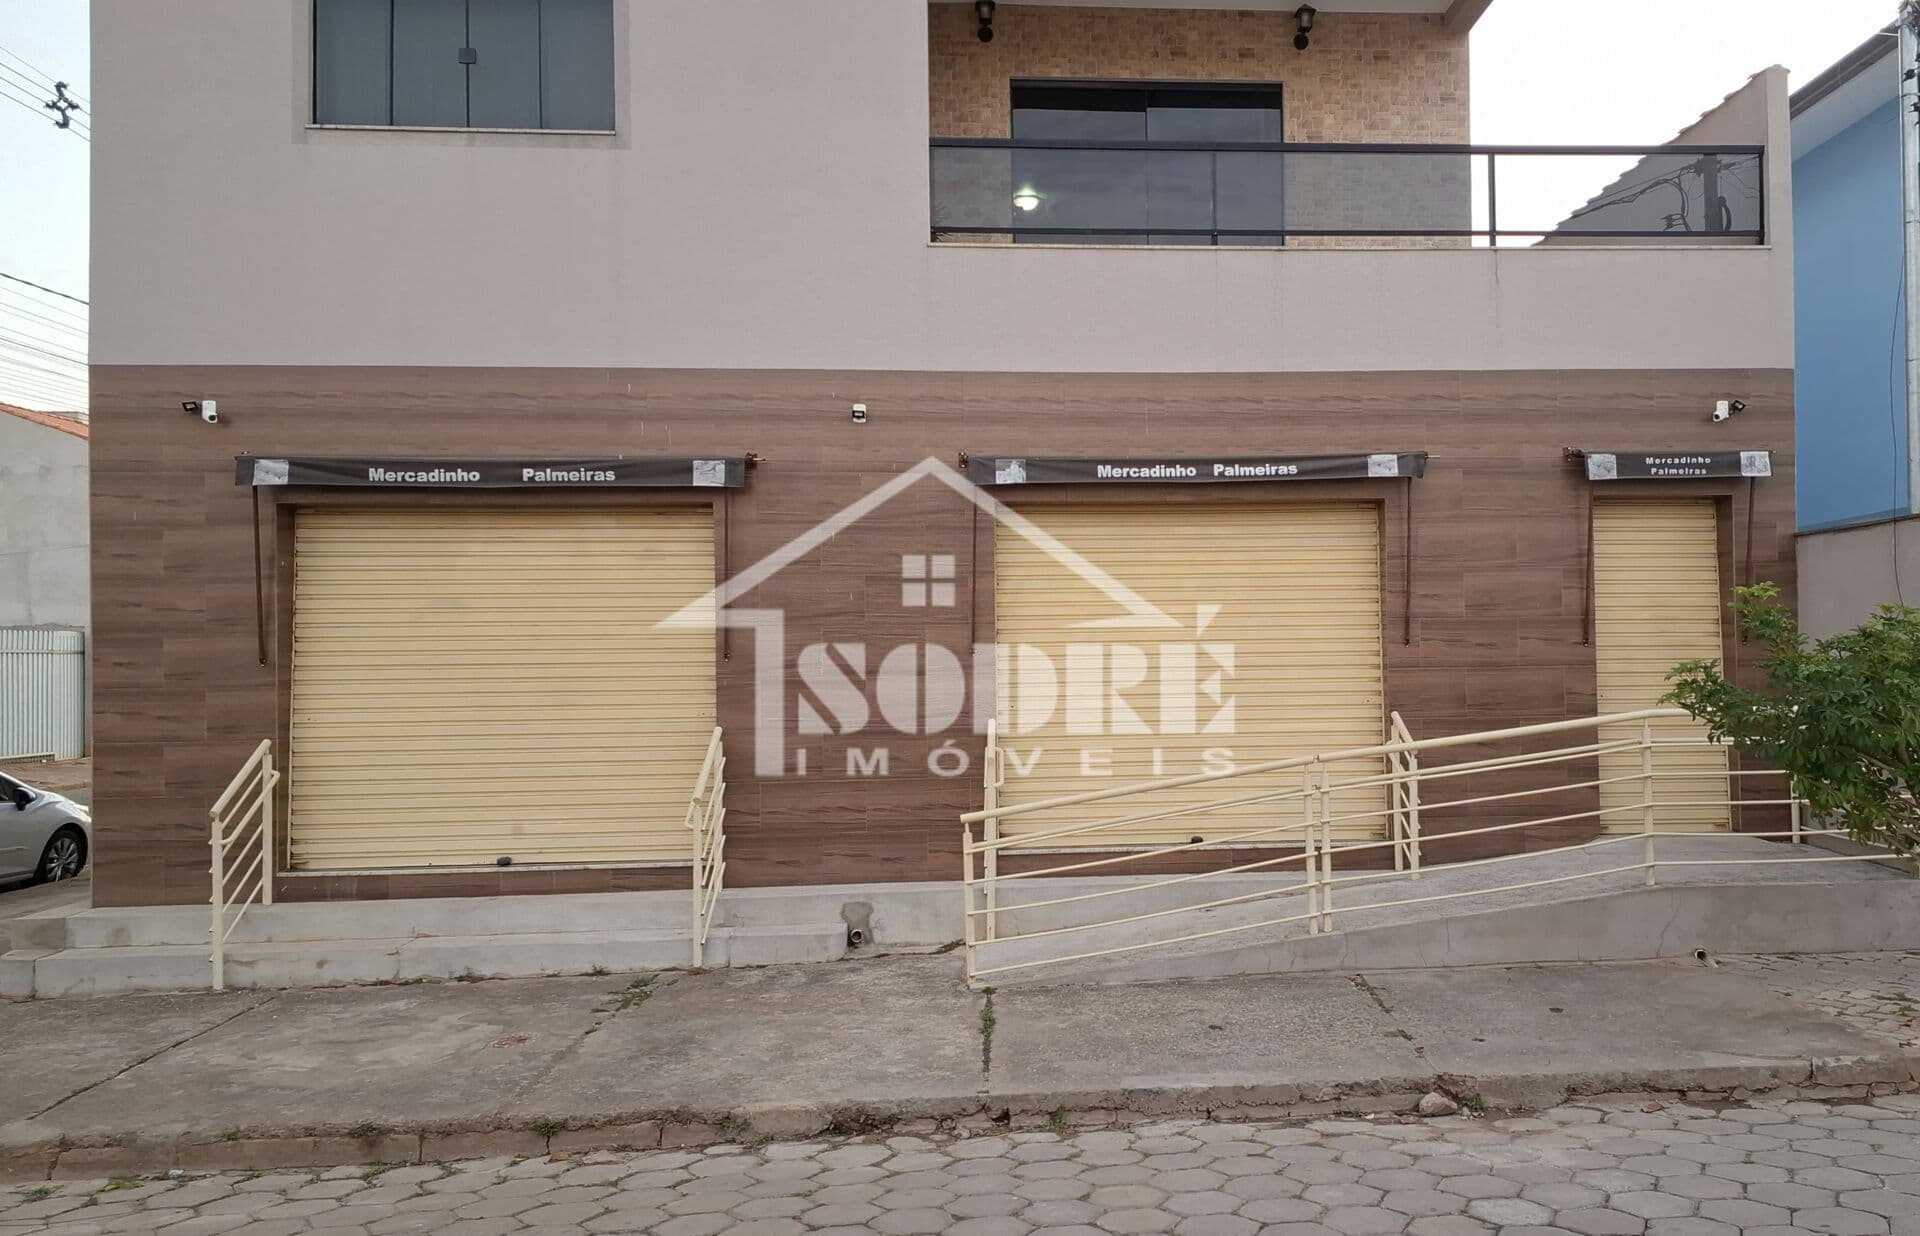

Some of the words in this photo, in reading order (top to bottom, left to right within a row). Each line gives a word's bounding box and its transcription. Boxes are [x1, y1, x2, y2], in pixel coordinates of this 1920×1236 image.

[368, 467, 480, 483] Mercadinho
[522, 467, 616, 482] Palmeiras
[1097, 464, 1197, 479] Mercadinho
[1213, 463, 1298, 477] Palmeiras
[1651, 467, 1707, 475] Palmeiras
